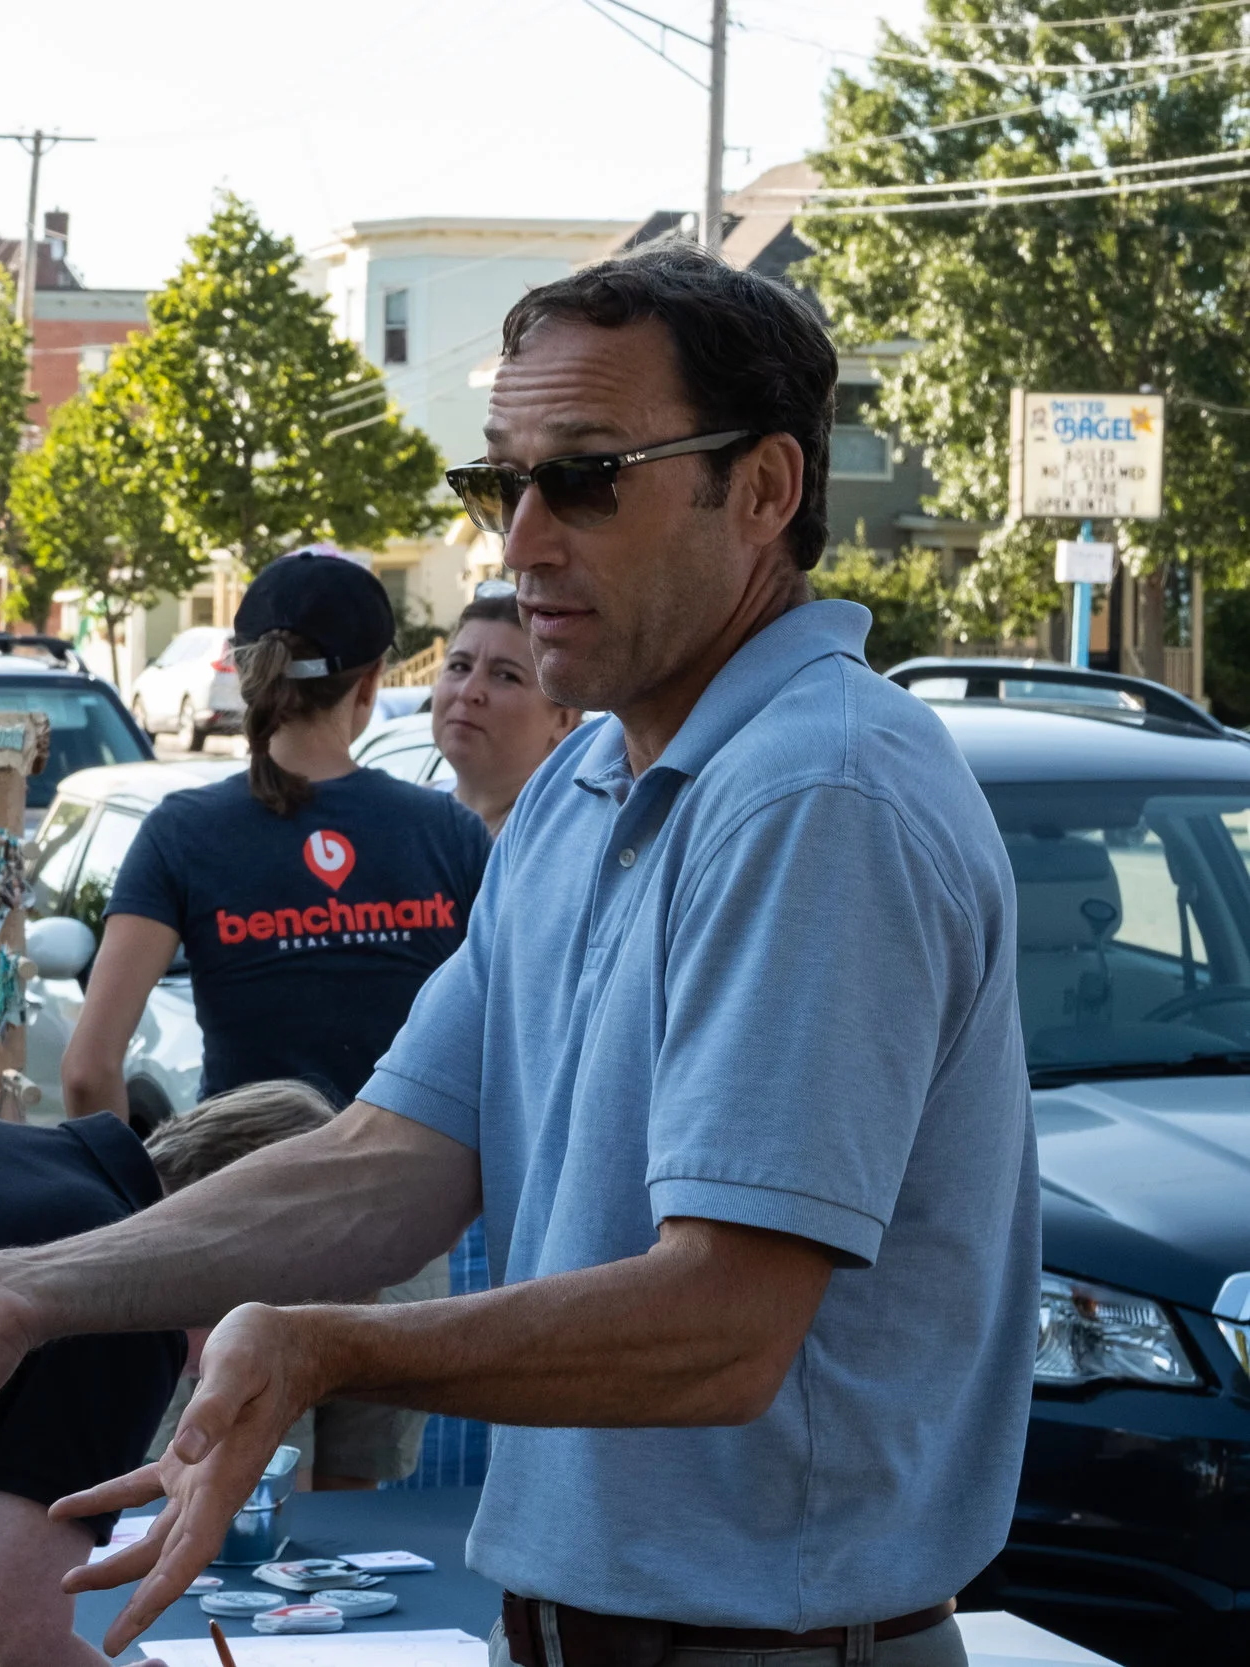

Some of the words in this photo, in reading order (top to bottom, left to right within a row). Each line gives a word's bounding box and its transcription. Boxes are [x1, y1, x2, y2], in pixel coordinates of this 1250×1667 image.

[1054, 416, 1137, 444] BAGEL
[216, 892, 455, 945] benchmark
[278, 936, 330, 950] REAL
[342, 931, 411, 945] ESTATE
